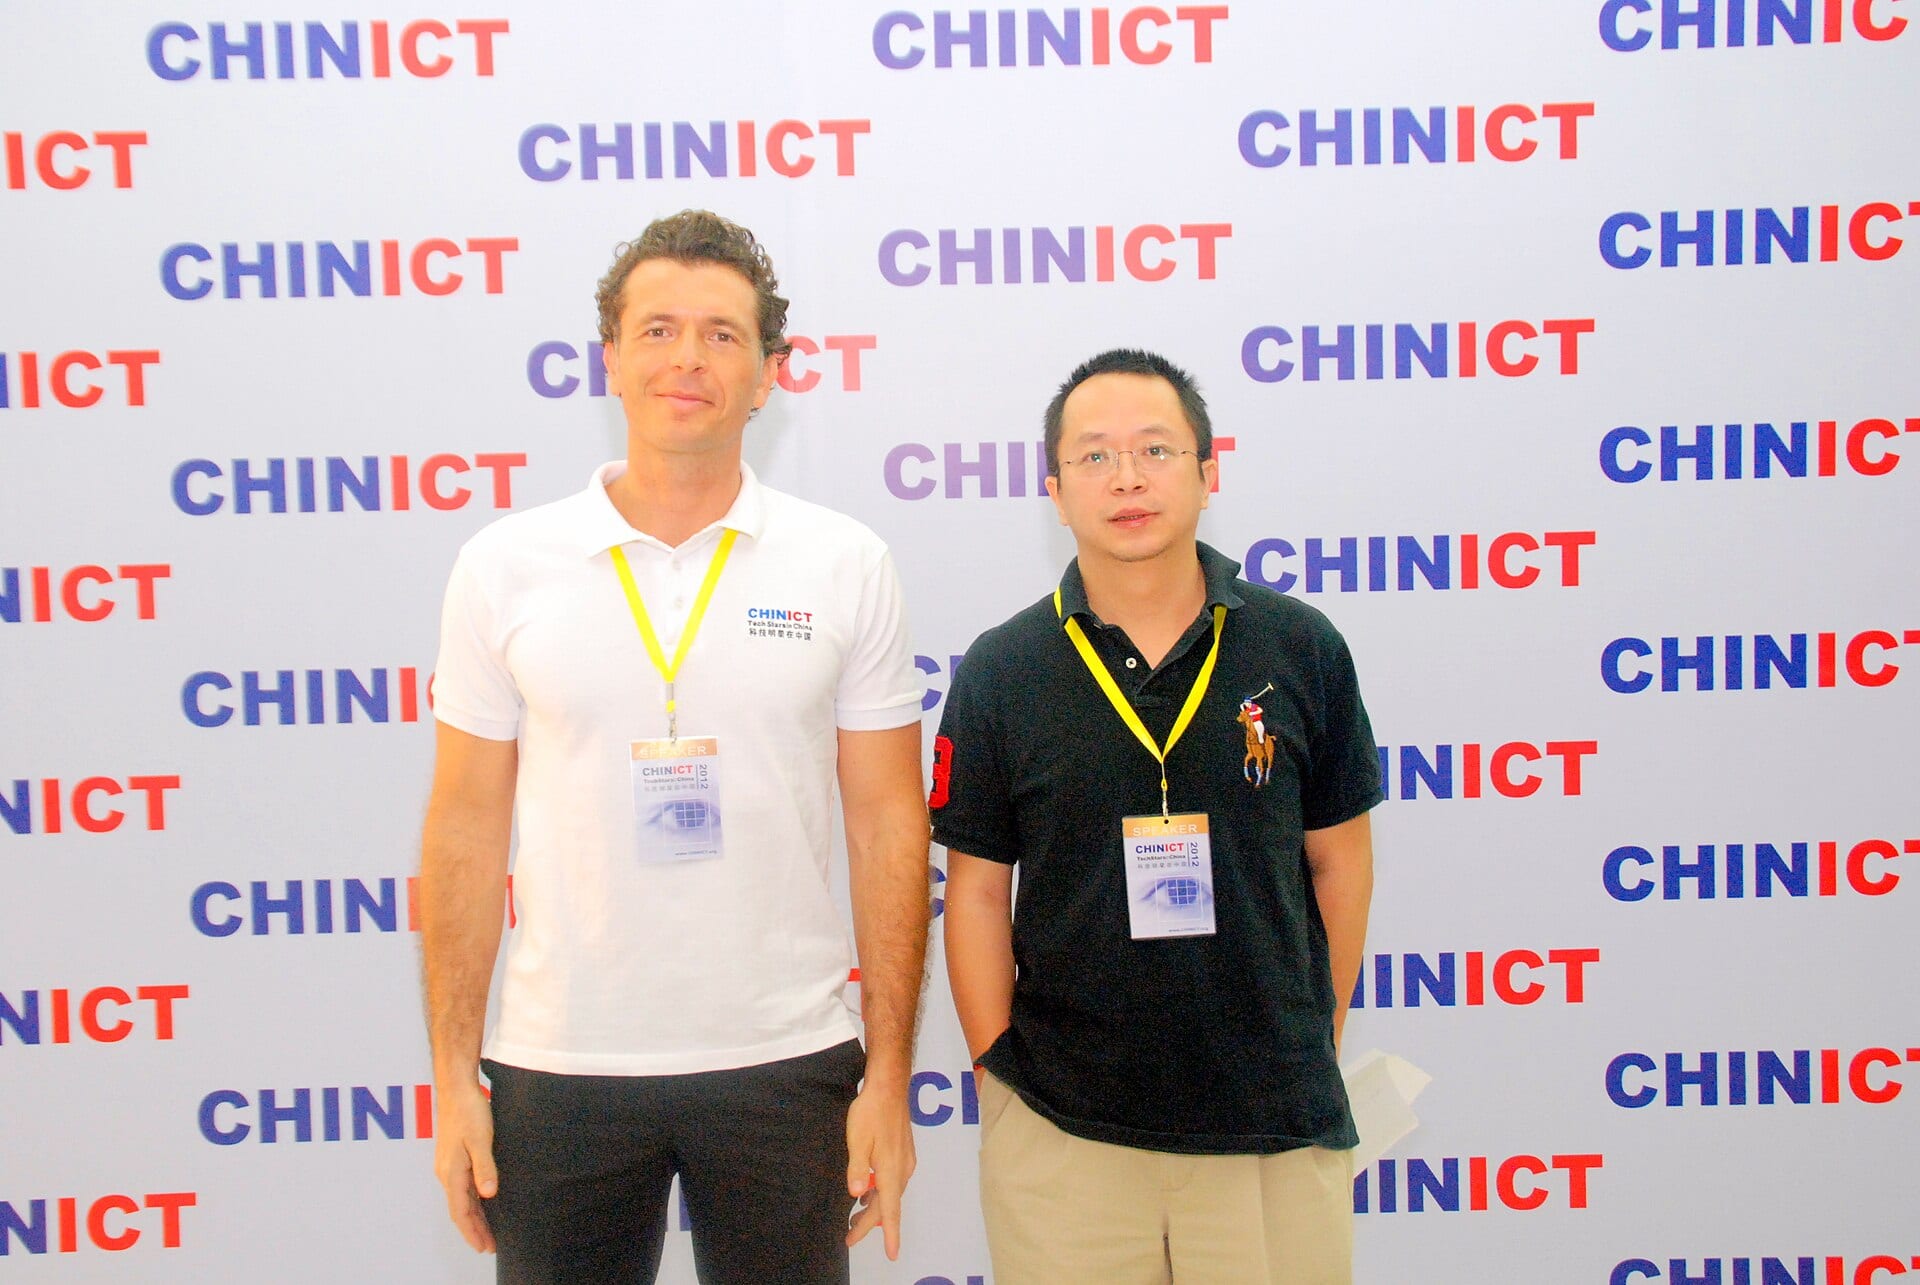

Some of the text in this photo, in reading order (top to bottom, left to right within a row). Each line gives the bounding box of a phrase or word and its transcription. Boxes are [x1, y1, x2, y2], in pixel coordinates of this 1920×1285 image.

[146, 19, 510, 81] CHINICT
[873, 5, 1229, 69] CHINICT
[4, 130, 148, 190] ICT
[519, 119, 871, 181] CHINICT
[1238, 102, 1595, 168] CHINICT
[878, 223, 1233, 287] CHINICT
[1598, 201, 1920, 270] CHINIC
[160, 237, 519, 301] CHINICT
[0, 349, 161, 408] ICT
[1241, 318, 1596, 384] CHINICT
[1598, 417, 1920, 484] CHINIC
[171, 452, 528, 517] CHINICT
[1244, 530, 1597, 593] CHINICT
[748, 608, 813, 622] CHINICT
[181, 667, 435, 728] CHINI
[642, 765, 694, 776] CHINICT
[699, 764, 709, 790] 2012
[1133, 824, 1198, 837] SPEAKER
[1135, 843, 1184, 854] CHINICT
[1190, 842, 1200, 867] 2012
[1348, 948, 1601, 1009] INICT
[0, 984, 191, 1044] NICT
[1605, 1047, 1920, 1109] CHINIC
[0, 1192, 198, 1256] NICT
[1608, 1254, 1920, 1285] CHINIC
